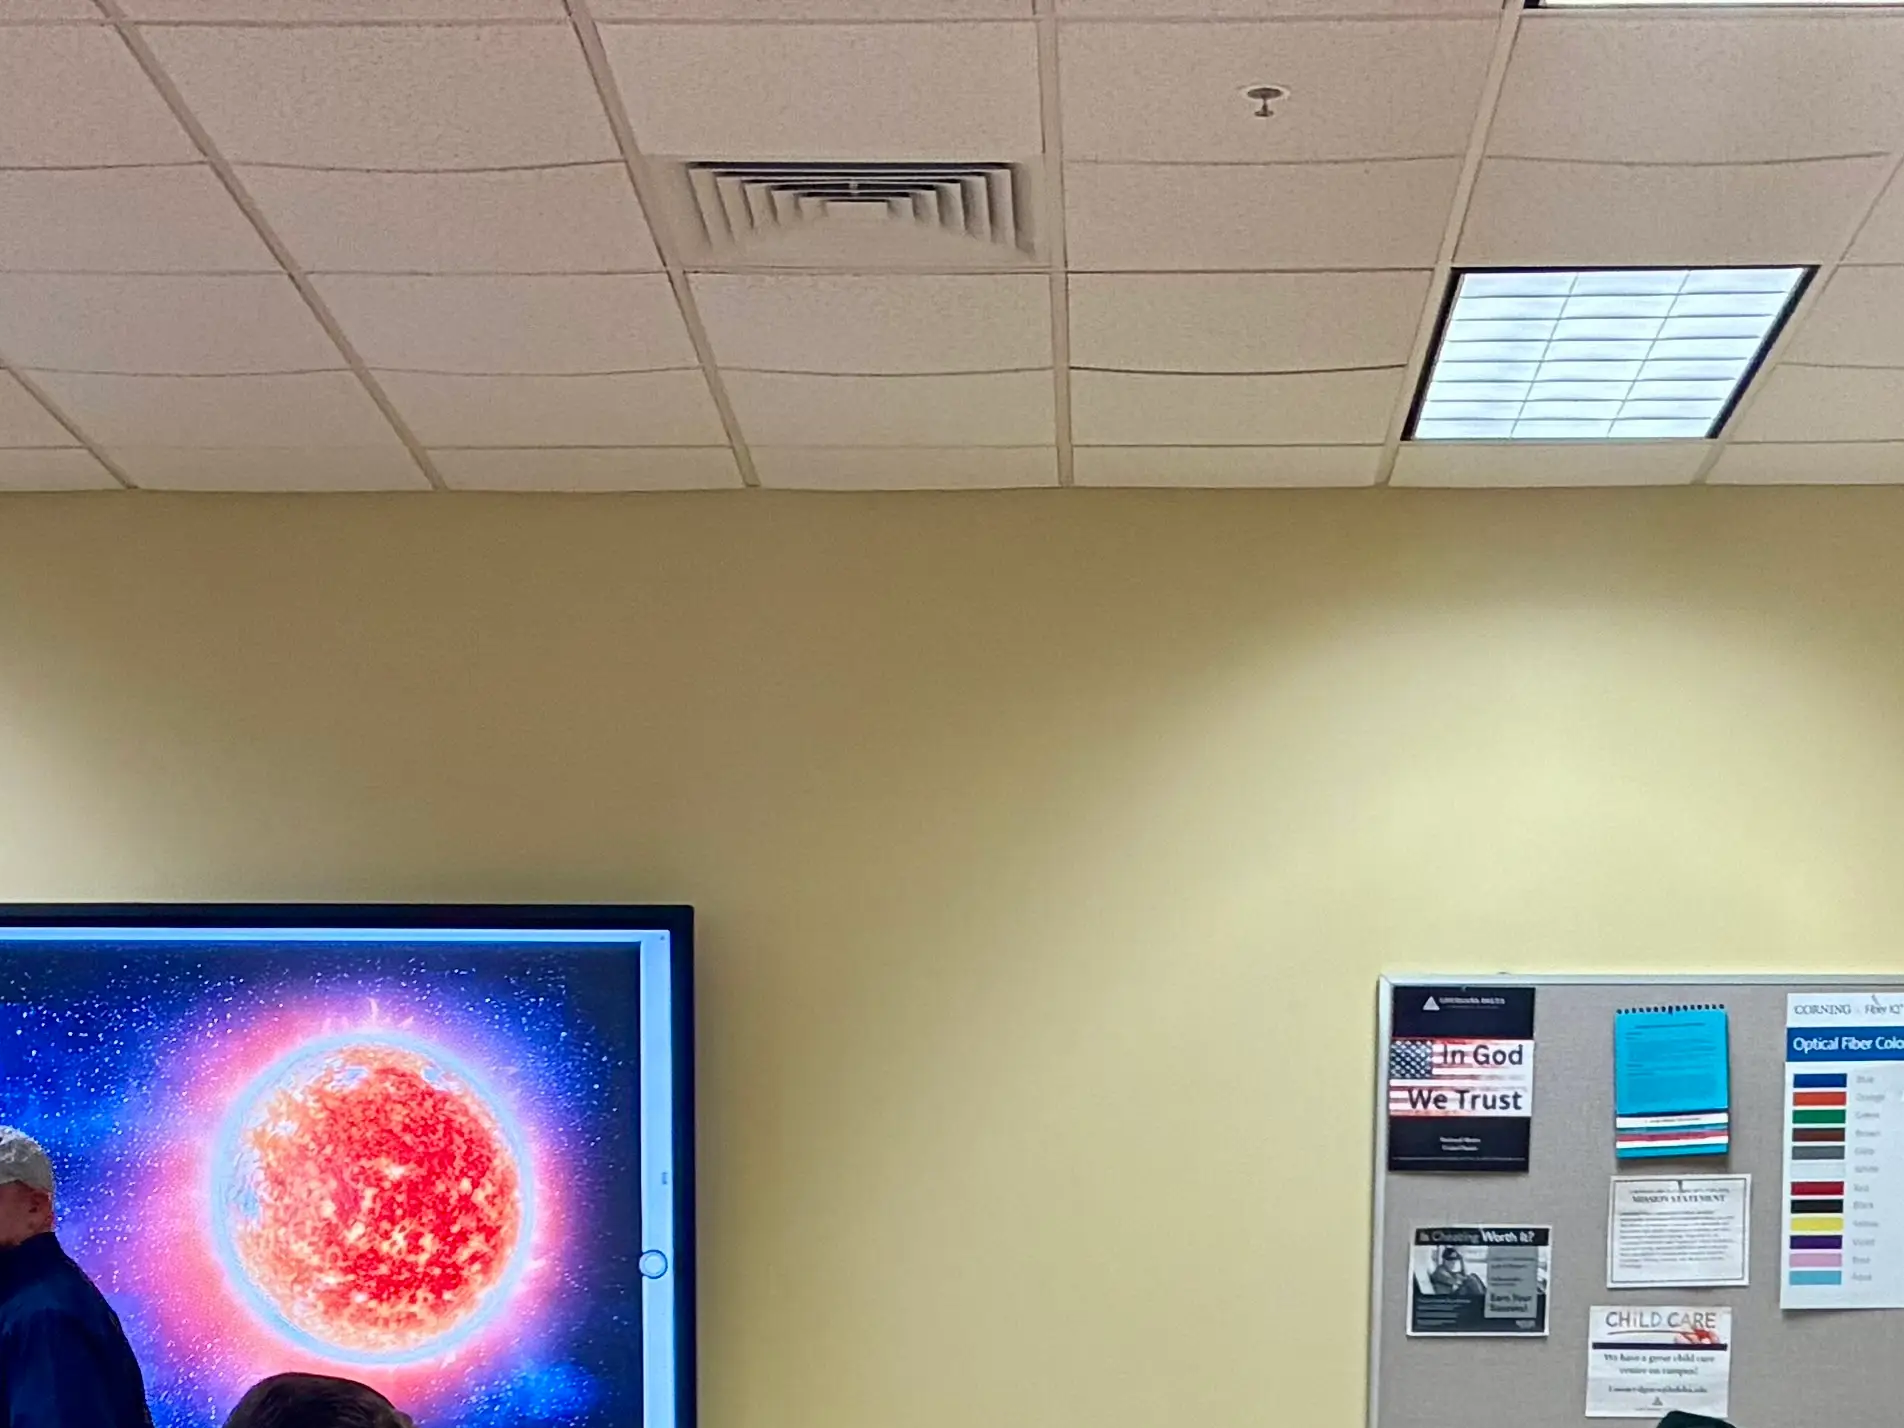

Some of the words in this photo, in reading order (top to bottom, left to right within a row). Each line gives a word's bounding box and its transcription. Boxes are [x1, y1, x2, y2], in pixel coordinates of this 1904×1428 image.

[1794, 1003, 1852, 1015] CORNING
[1442, 1044, 1466, 1066] In
[1473, 1043, 1524, 1066] God
[1792, 1036, 1839, 1055] Optical
[1841, 1036, 1873, 1050] Fiber
[1408, 1089, 1448, 1111] We
[1455, 1089, 1523, 1111] Trust
[1481, 1230, 1518, 1243] Worth
[1667, 1311, 1717, 1329] CARE
